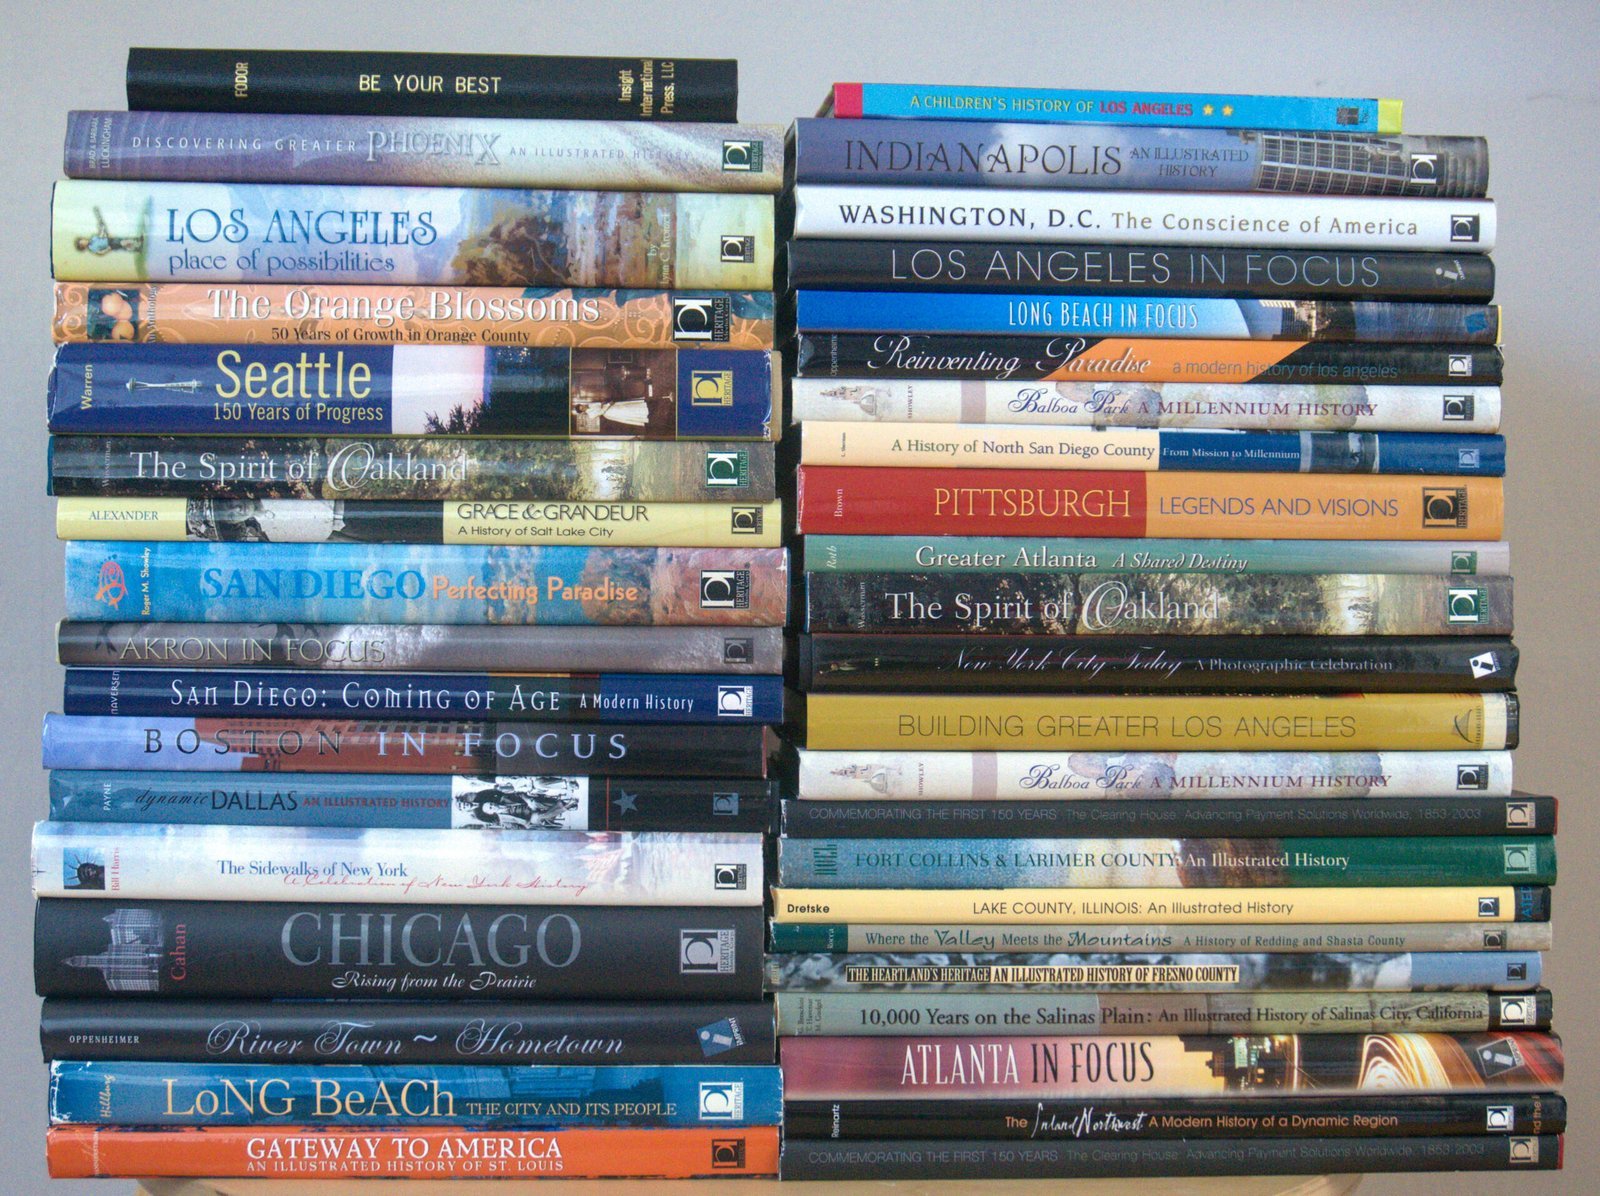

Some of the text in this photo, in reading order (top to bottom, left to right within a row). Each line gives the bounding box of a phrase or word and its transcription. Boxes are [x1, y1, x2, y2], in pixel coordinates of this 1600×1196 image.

[235, 62, 249, 97] FODOR
[661, 61, 674, 78] LLC
[359, 74, 501, 94] BE YOUR BEST
[618, 69, 633, 102] Insight
[640, 59, 653, 117] International
[910, 95, 1193, 117] A CHILDREN'S HISTORY OF LOS ANGELES
[102, 118, 112, 168] LUCKINGHAM
[132, 131, 501, 165] DISCOVERING GREATER PHOENIX
[844, 140, 1123, 175] INDIANAPOLIS
[167, 208, 438, 246] LOS ANGELES
[839, 205, 1418, 235] WASHINGTON, D.C. The Conscience of America
[170, 249, 395, 276] place of possibilities
[891, 249, 1380, 287] LOS ANGELES IN FOCUS
[208, 290, 600, 327] The Orange Blossoms
[1009, 301, 1199, 329] LONG BEACH IN FOCUS
[271, 327, 530, 344] 50 Years of Growth in Orange County
[81, 364, 93, 410] Warren
[216, 350, 371, 398] Seattle
[724, 370, 732, 406] HERITAGE
[213, 403, 384, 424] 150 Years of Progress
[891, 440, 1155, 459] A History of North San Diego County
[88, 510, 159, 521] ALEXANDER
[457, 503, 649, 522] GRACE & GRANDEUR
[834, 489, 844, 518] Brown
[934, 488, 1131, 518] PITTSBURGH
[1159, 497, 1399, 517] LEGENDS AND VISIONS
[458, 526, 614, 539] A History of Salt Lake City
[141, 547, 150, 616] Roger M. Showley
[202, 568, 638, 604] SAN DIEGO Perfecting Paradise
[119, 638, 385, 662] AKRON IN FOCUS
[898, 715, 1357, 738] BUILDING GREATER LOS ANGELES
[211, 790, 298, 810] DALLAS
[809, 808, 1057, 821] COMMEMORATING THE FIRST 150 YEARS
[217, 860, 407, 877] The Sidewalks of New York
[856, 853, 1095, 868] FORT COLLINS & LARIMER
[787, 904, 830, 914] Dretske
[973, 902, 1294, 917] LAKE COUNTY, ILLINOIS: An Illustrated History
[170, 924, 186, 981] Cahan
[281, 912, 582, 967] CHICAGO
[721, 930, 729, 973] HERITAGE
[849, 967, 1238, 982] THE HEARTLAND'S HERITAGE AN ILLUSTRATED HISTORY OF FRESNO COUNTY
[860, 1007, 1152, 1026] 10,000 Years on the Salinas Plain:
[70, 1035, 140, 1044] OPPENHEIMER
[206, 1020, 303, 1055] River
[314, 1020, 402, 1055] Town
[455, 1018, 625, 1055] Hometown
[900, 1042, 1154, 1085] ATLANTA IN FOCUS
[466, 1102, 500, 1116] THE
[504, 1102, 541, 1116] CITY
[545, 1103, 581, 1116] AND
[585, 1103, 610, 1116] ITS
[614, 1103, 677, 1116] PEOPLE
[831, 1104, 840, 1138] Reinartz
[247, 1137, 563, 1160] GATEWAY TO AMERICA
